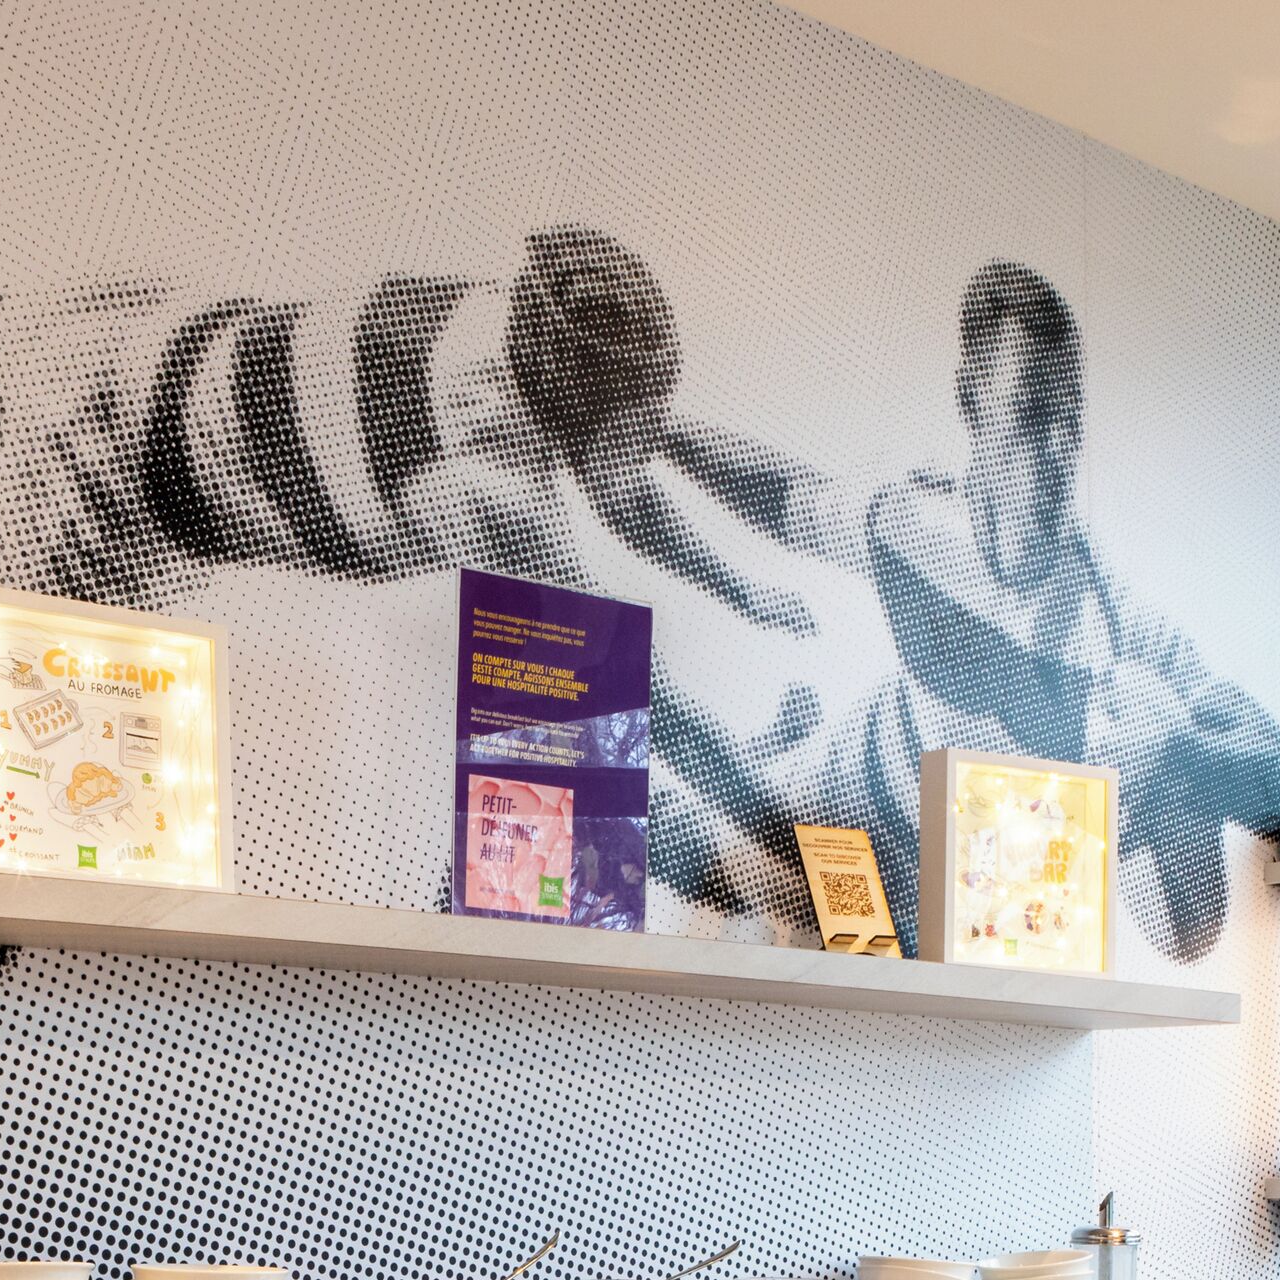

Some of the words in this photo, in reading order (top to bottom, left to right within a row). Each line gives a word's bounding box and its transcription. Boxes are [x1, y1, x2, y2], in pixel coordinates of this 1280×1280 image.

[472, 652, 483, 663] ON
[484, 654, 512, 669] COMPTE
[512, 659, 526, 671] SUR
[526, 661, 544, 674] VOUS
[548, 666, 575, 680] CHAQUE
[472, 663, 492, 676] GESTE
[493, 666, 522, 681] COMPTE,
[523, 672, 555, 687] AGISSONS
[555, 678, 589, 693] ENSEMBLE
[472, 673, 491, 685] POUR
[492, 678, 506, 688] UNE
[548, 687, 580, 701] POSITIVE.
[68, 679, 85, 692] AU
[91, 683, 143, 699] FROMAGE
[0, 709, 12, 730] 1
[102, 722, 114, 740] 2
[529, 742, 548, 753] ACTION
[482, 794, 517, 815] PETIT-
[155, 811, 167, 831] 3
[544, 882, 559, 894] ibis
